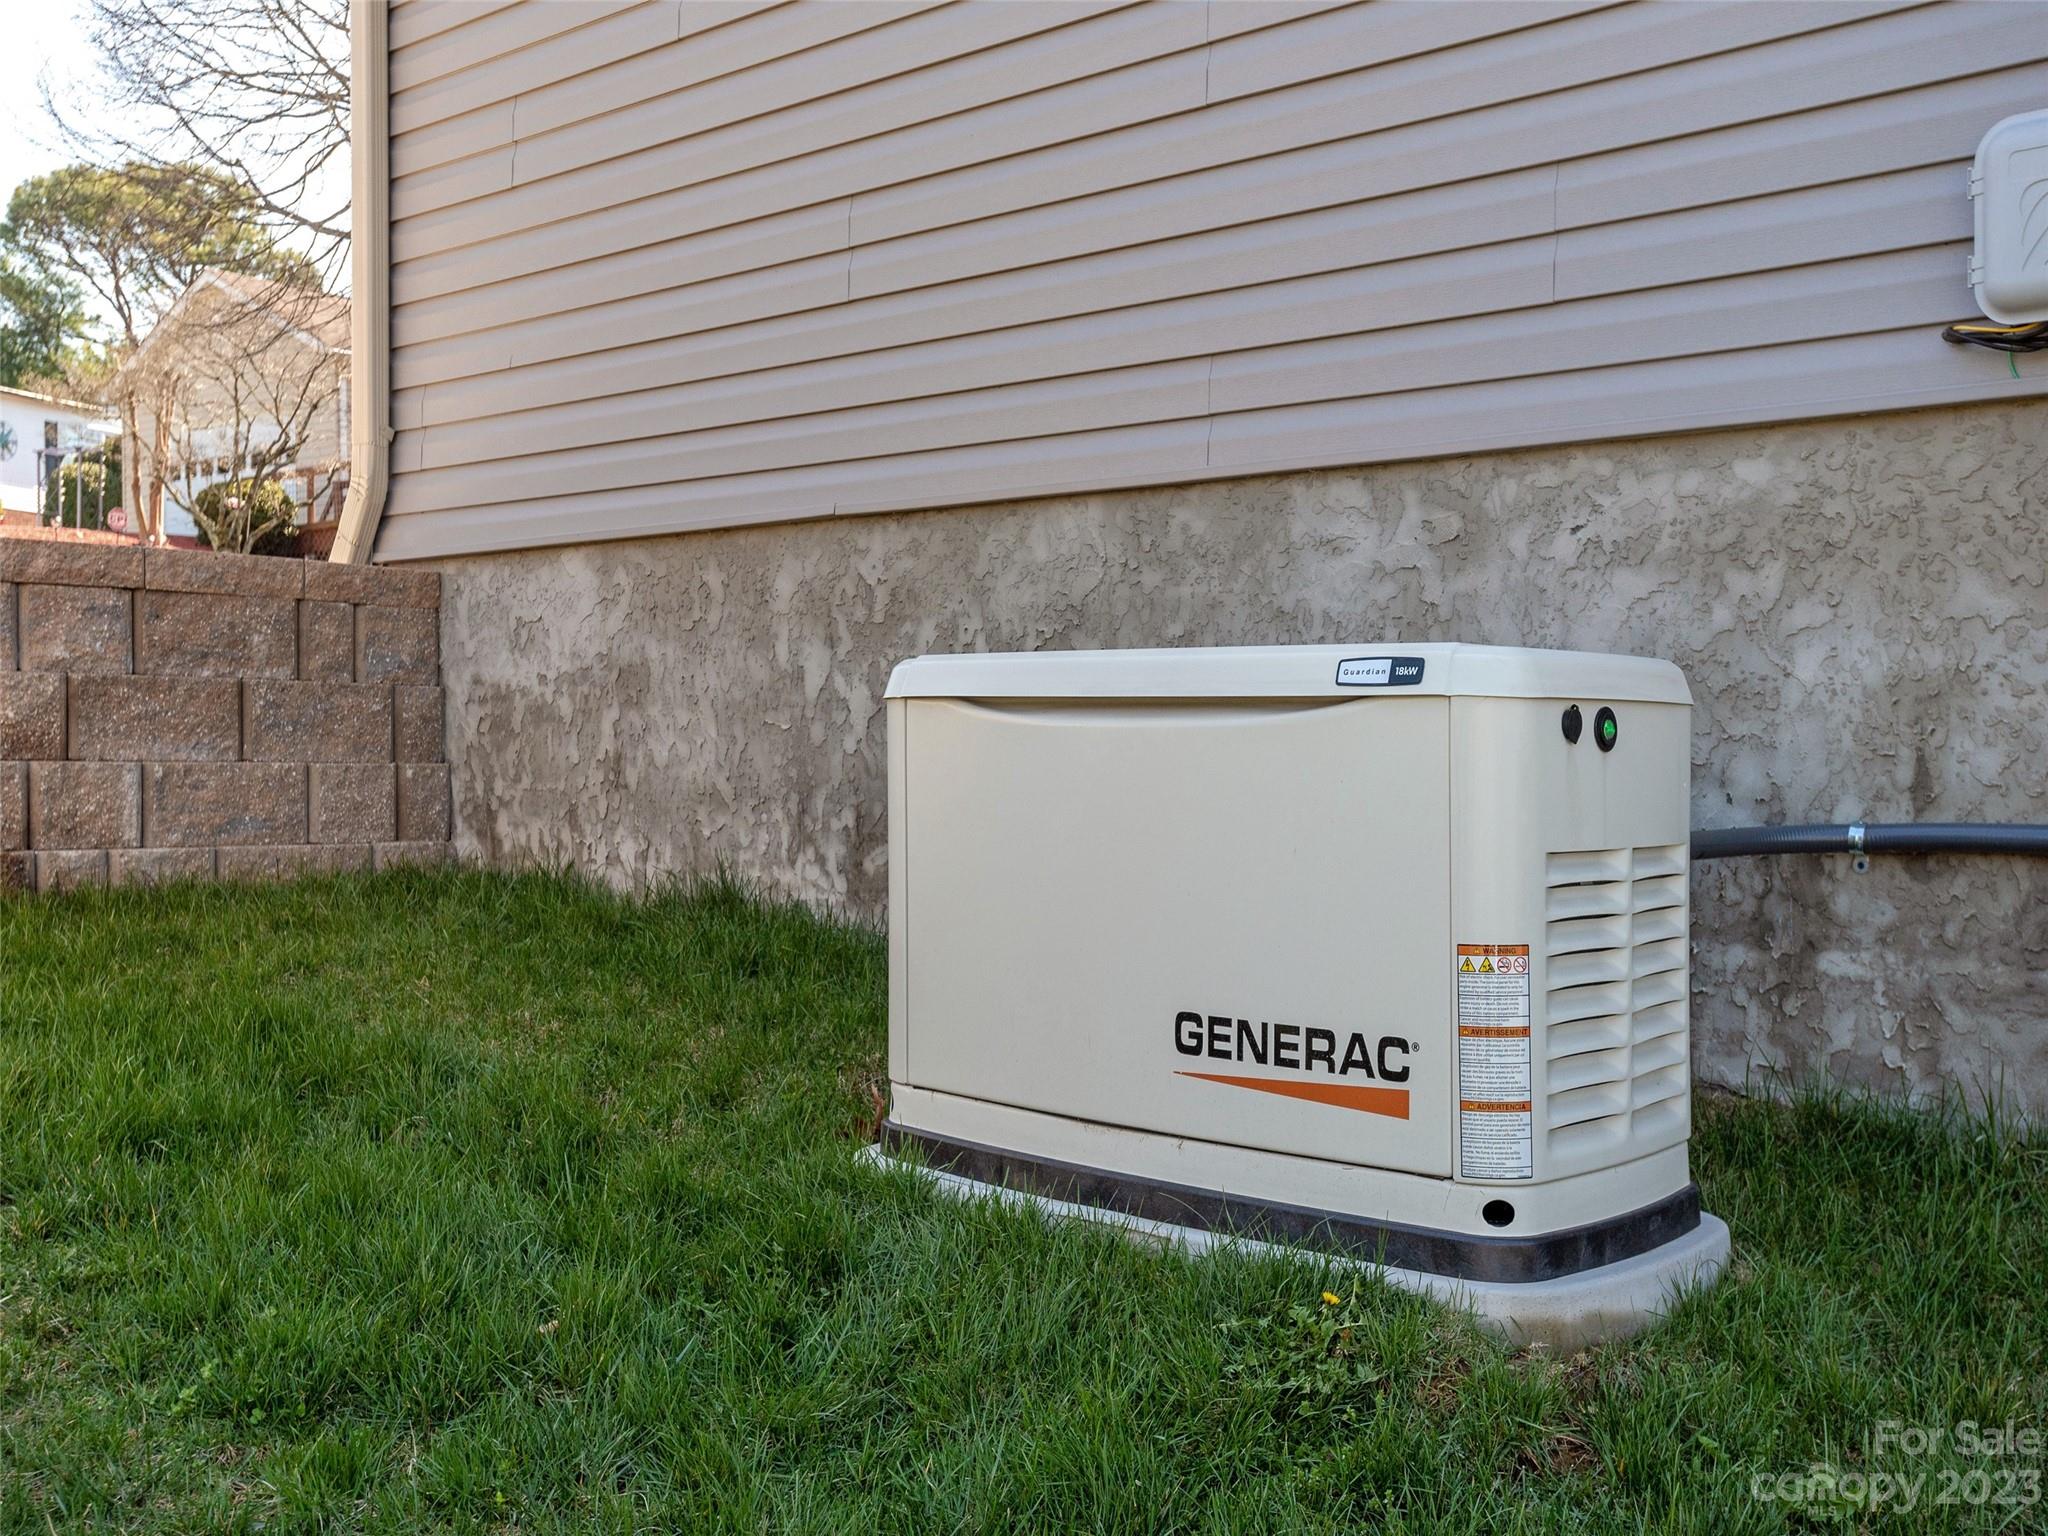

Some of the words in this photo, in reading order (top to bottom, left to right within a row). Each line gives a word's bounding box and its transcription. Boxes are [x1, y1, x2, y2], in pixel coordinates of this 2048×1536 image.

[1343, 668, 1386, 676] Guardian
[1395, 666, 1419, 676] 18kW
[1175, 1011, 1410, 1083] GENERAC
[1477, 1103, 1526, 1111] ADVERTENCIA
